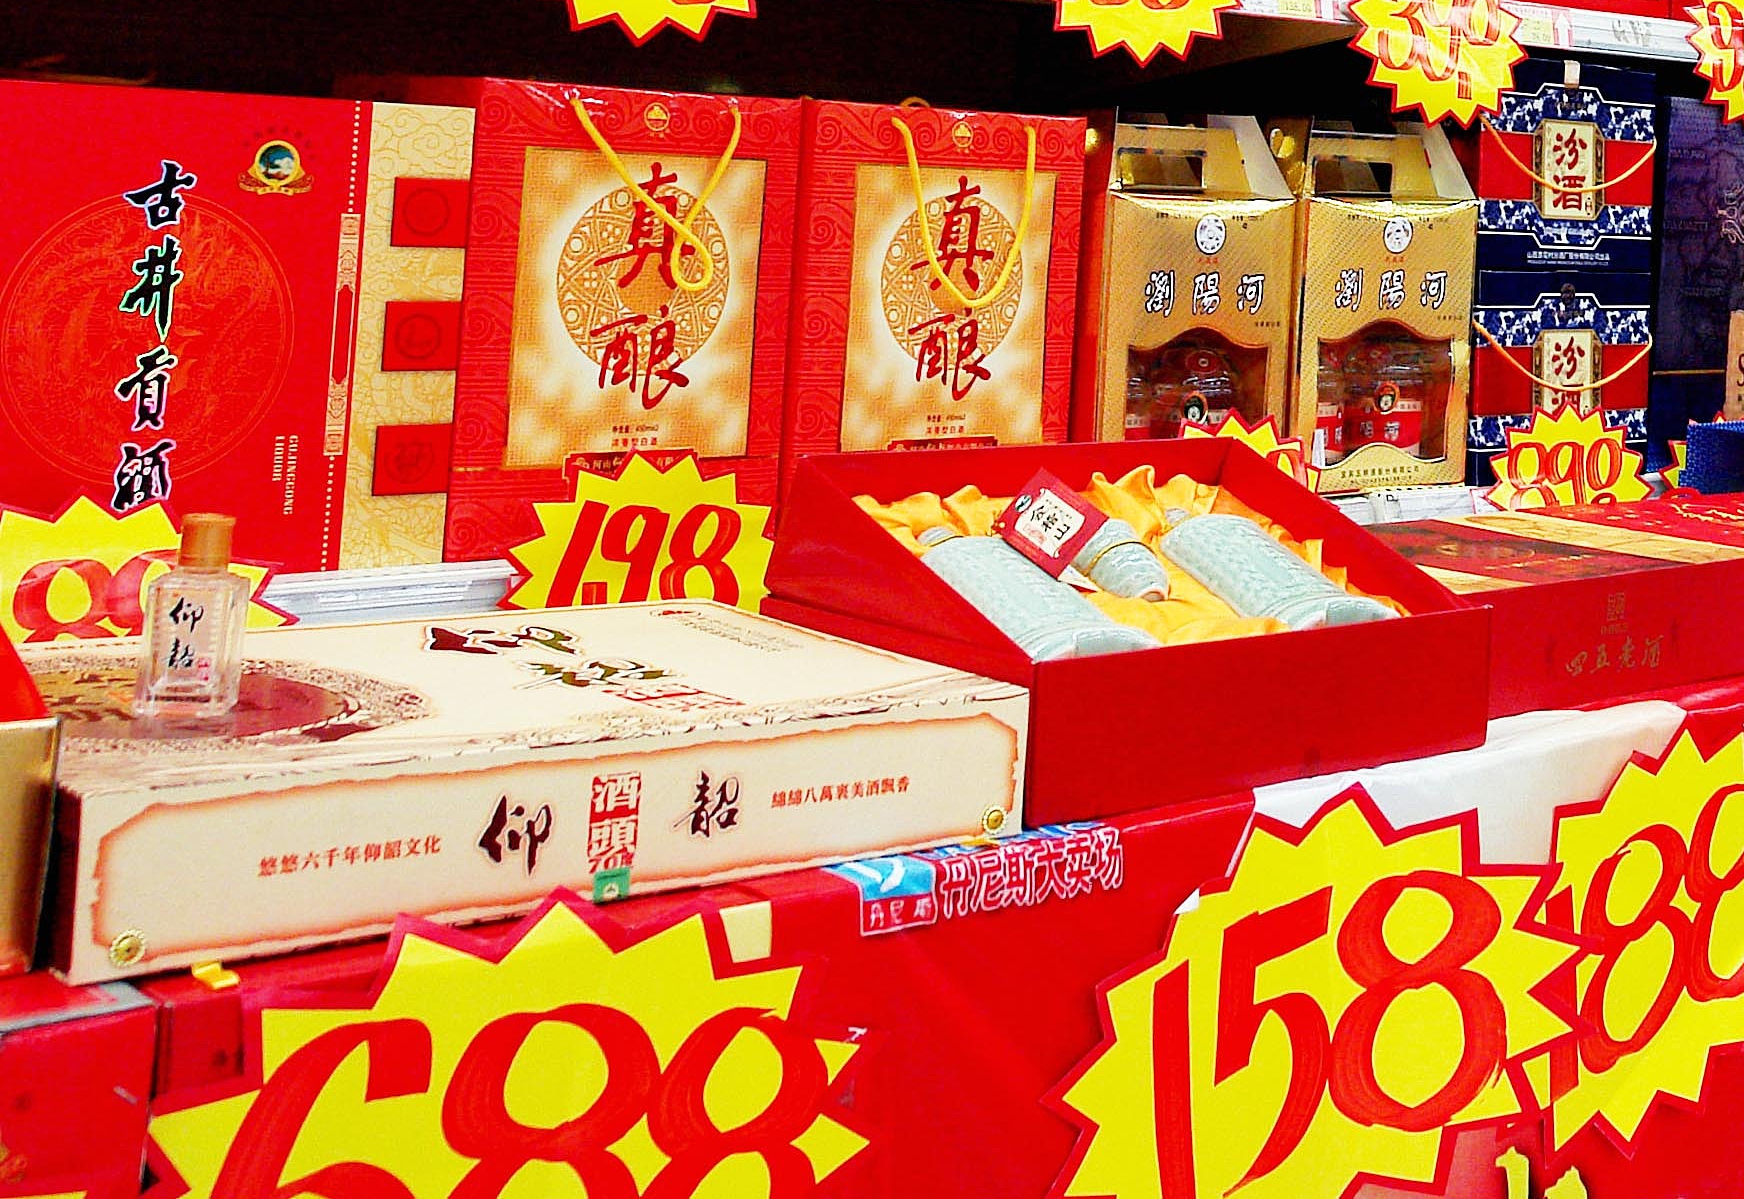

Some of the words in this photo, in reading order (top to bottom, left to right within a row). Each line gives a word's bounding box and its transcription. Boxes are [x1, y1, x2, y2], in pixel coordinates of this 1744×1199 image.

[1552, 127, 1589, 209] 汾酒
[478, 796, 552, 875] 仰
[674, 771, 743, 840] 韶
[257, 835, 442, 878] 悠悠六千年仰韶文化
[939, 826, 1124, 919] 丹尼斯大卖场
[1153, 870, 1507, 1199] 158
